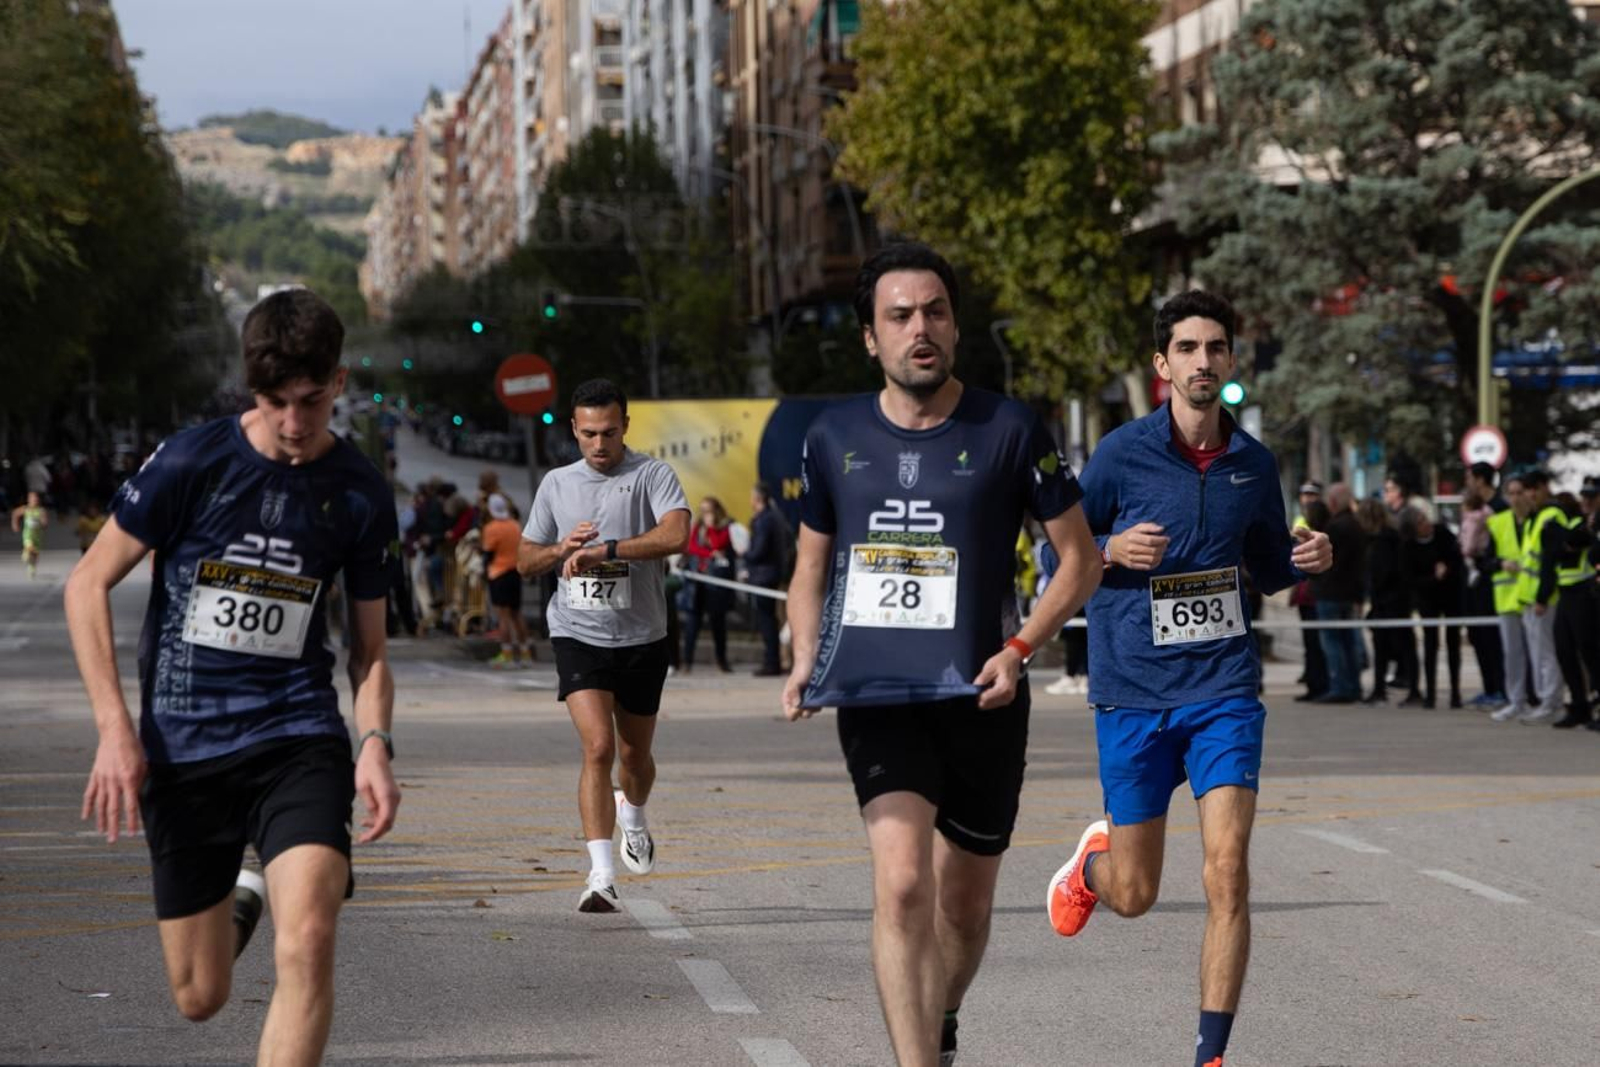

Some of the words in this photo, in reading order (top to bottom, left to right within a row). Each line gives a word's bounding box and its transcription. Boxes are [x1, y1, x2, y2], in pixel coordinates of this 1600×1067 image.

[868, 499, 945, 532] 25
[867, 531, 944, 543] CARRERA
[222, 533, 304, 575] 25
[201, 563, 230, 580] XXV
[580, 580, 617, 599] 127
[878, 578, 921, 610] 28
[213, 596, 284, 636] 380
[1172, 597, 1225, 627] 693
